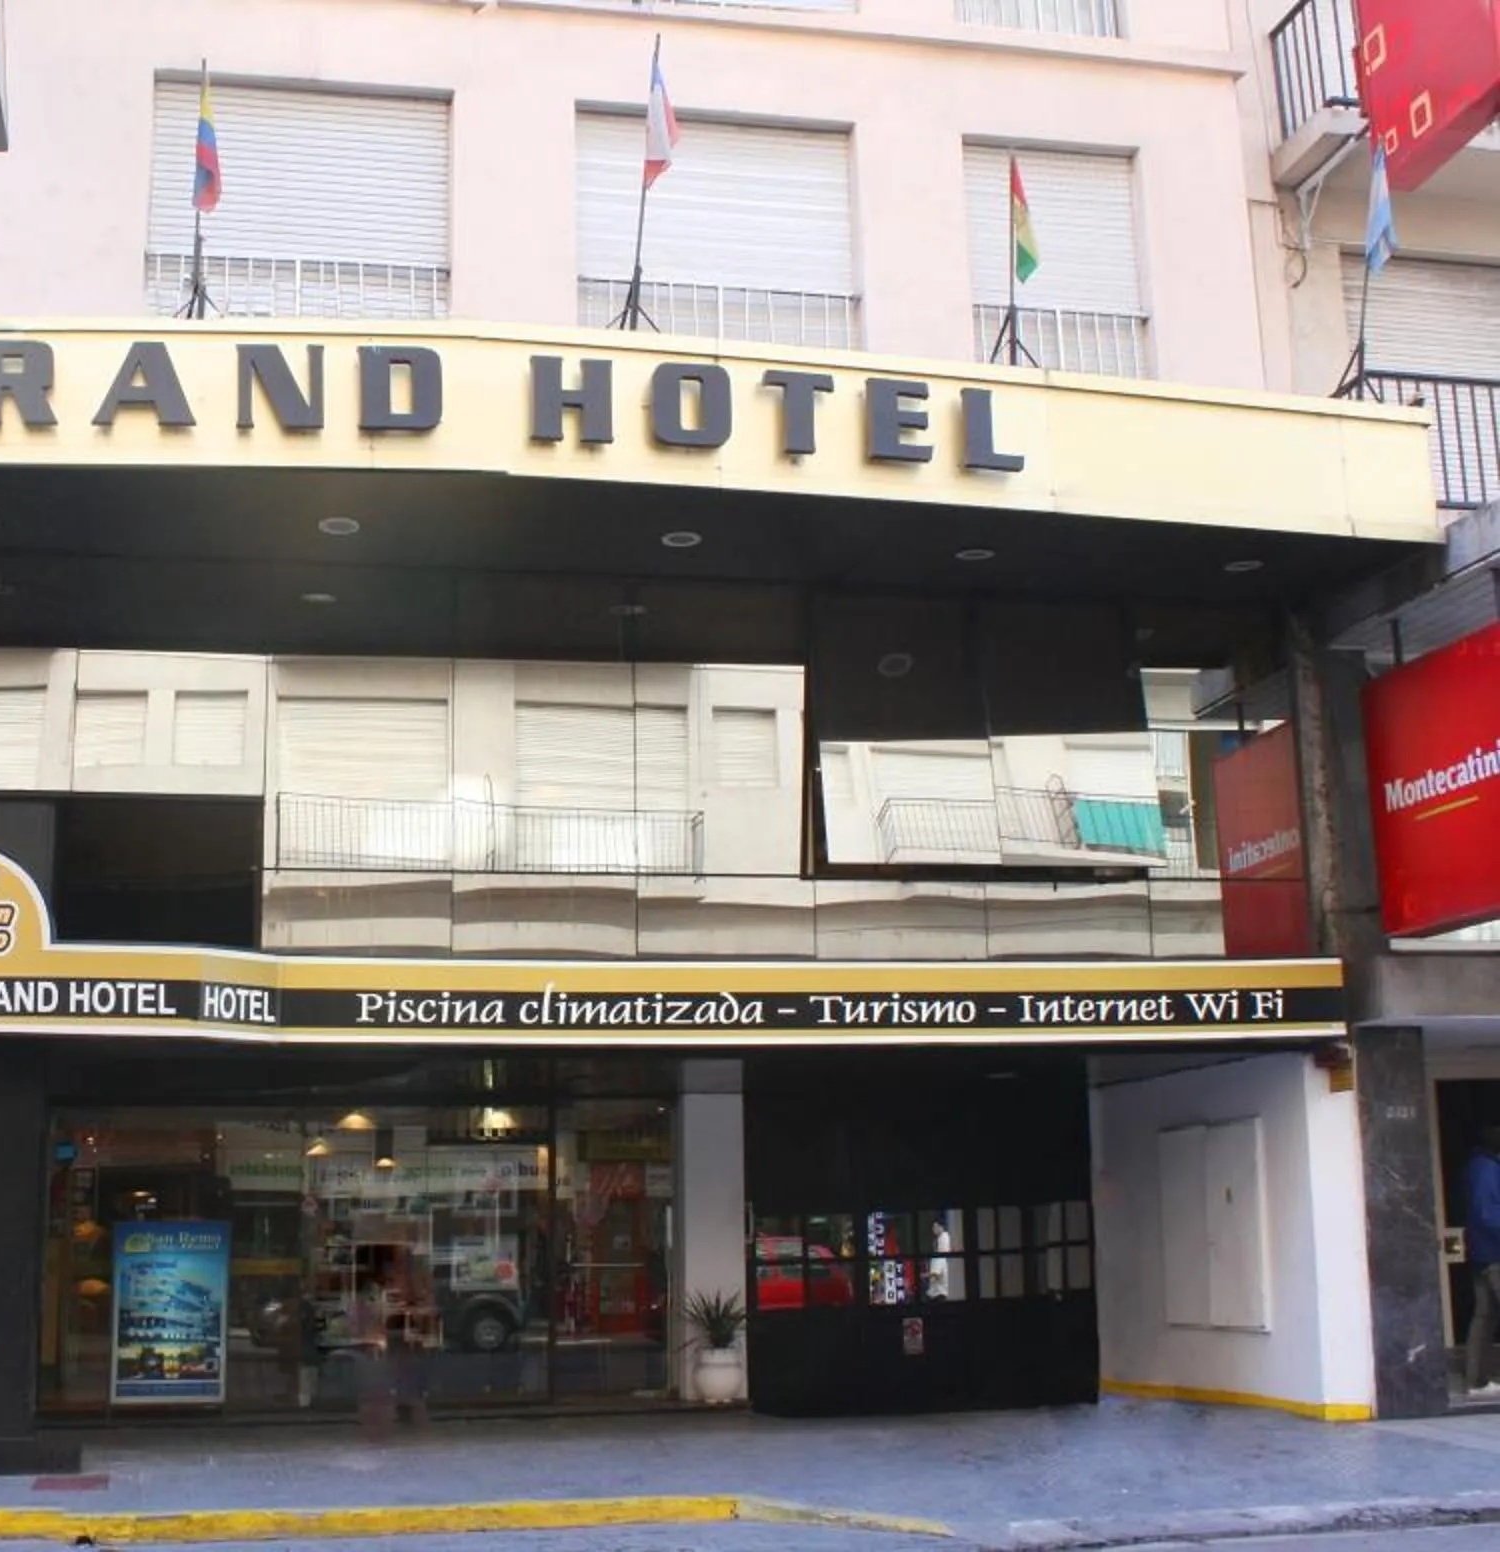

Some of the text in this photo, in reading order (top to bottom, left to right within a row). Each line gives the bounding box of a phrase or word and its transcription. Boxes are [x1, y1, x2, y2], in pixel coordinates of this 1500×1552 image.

[530, 354, 1025, 472] HOTEL
[68, 981, 177, 1016] HOTEL
[204, 985, 277, 1024] HOTEL
[355, 991, 505, 1024] Piscina
[519, 982, 765, 1025] climatizada
[810, 993, 976, 1024] Turismo
[1019, 993, 1174, 1023] Internet
[1185, 991, 1239, 1021] Wi
[1250, 989, 1285, 1020] Fi
